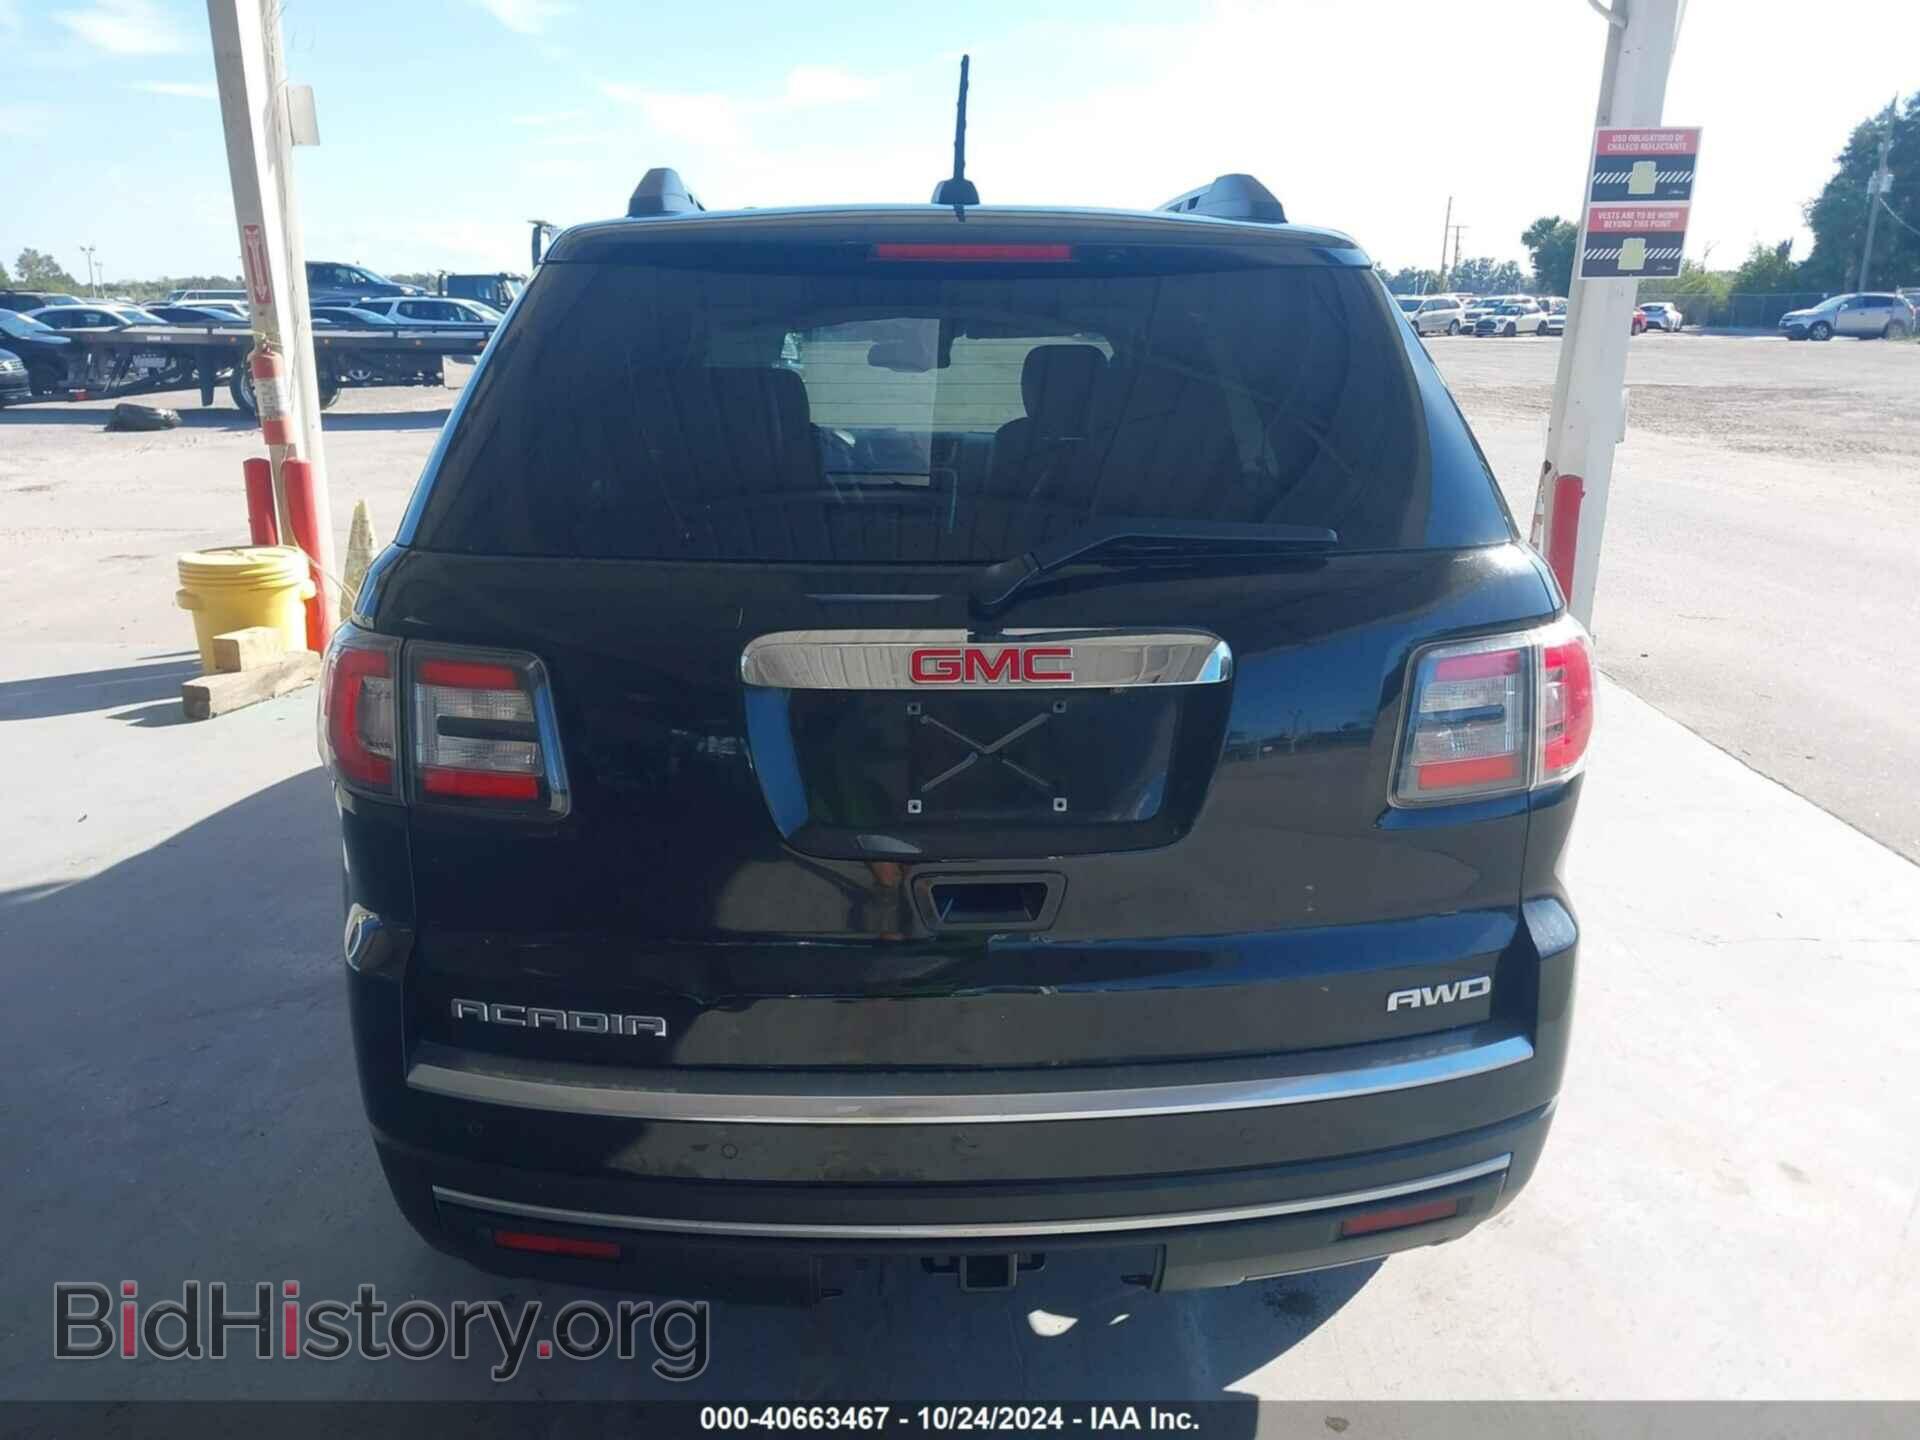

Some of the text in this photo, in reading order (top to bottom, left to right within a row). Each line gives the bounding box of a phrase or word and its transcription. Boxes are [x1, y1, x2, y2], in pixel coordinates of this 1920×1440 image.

[909, 646, 1073, 684] GMC
[1386, 975, 1492, 1012] AWD
[451, 998, 667, 1037] ACADIA
